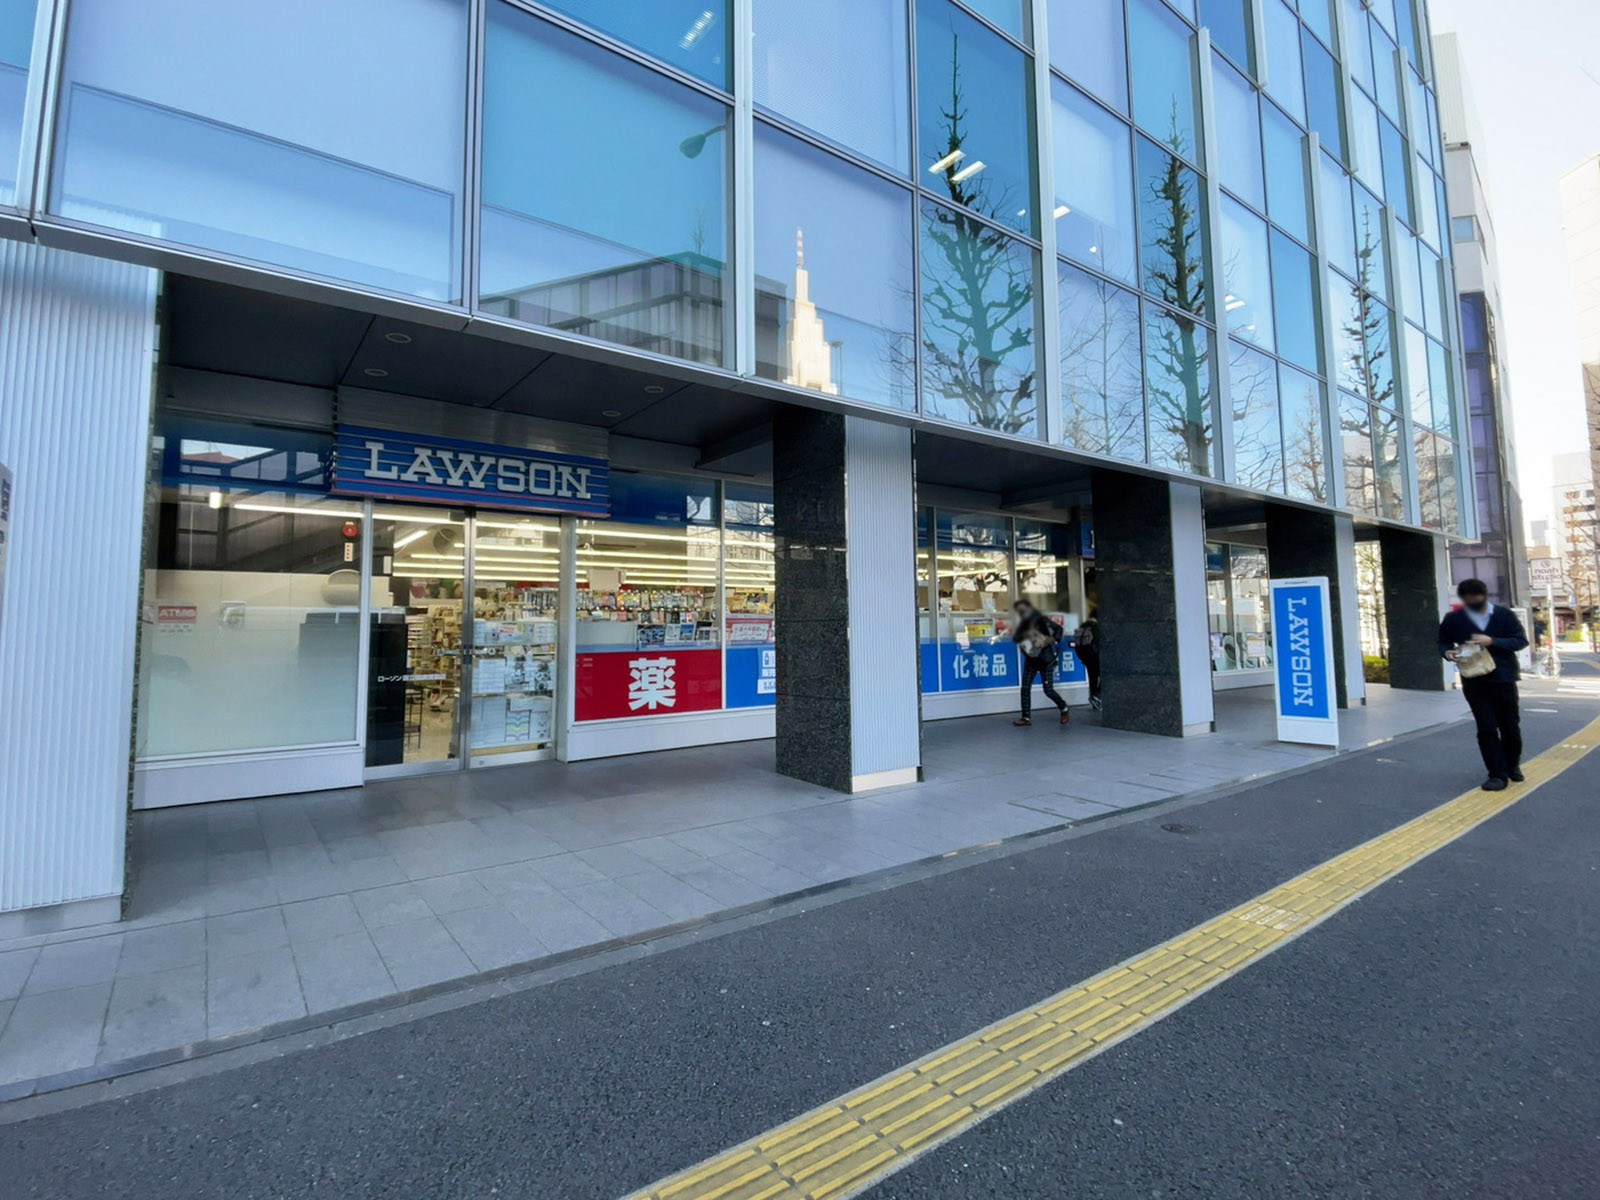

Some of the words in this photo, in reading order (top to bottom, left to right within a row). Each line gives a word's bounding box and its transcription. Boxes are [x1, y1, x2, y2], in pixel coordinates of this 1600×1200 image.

[364, 441, 592, 499] LAWSON
[952, 653, 1007, 679] 化粧品
[1287, 597, 1314, 707] LAWSON
[628, 657, 676, 711] 薬
